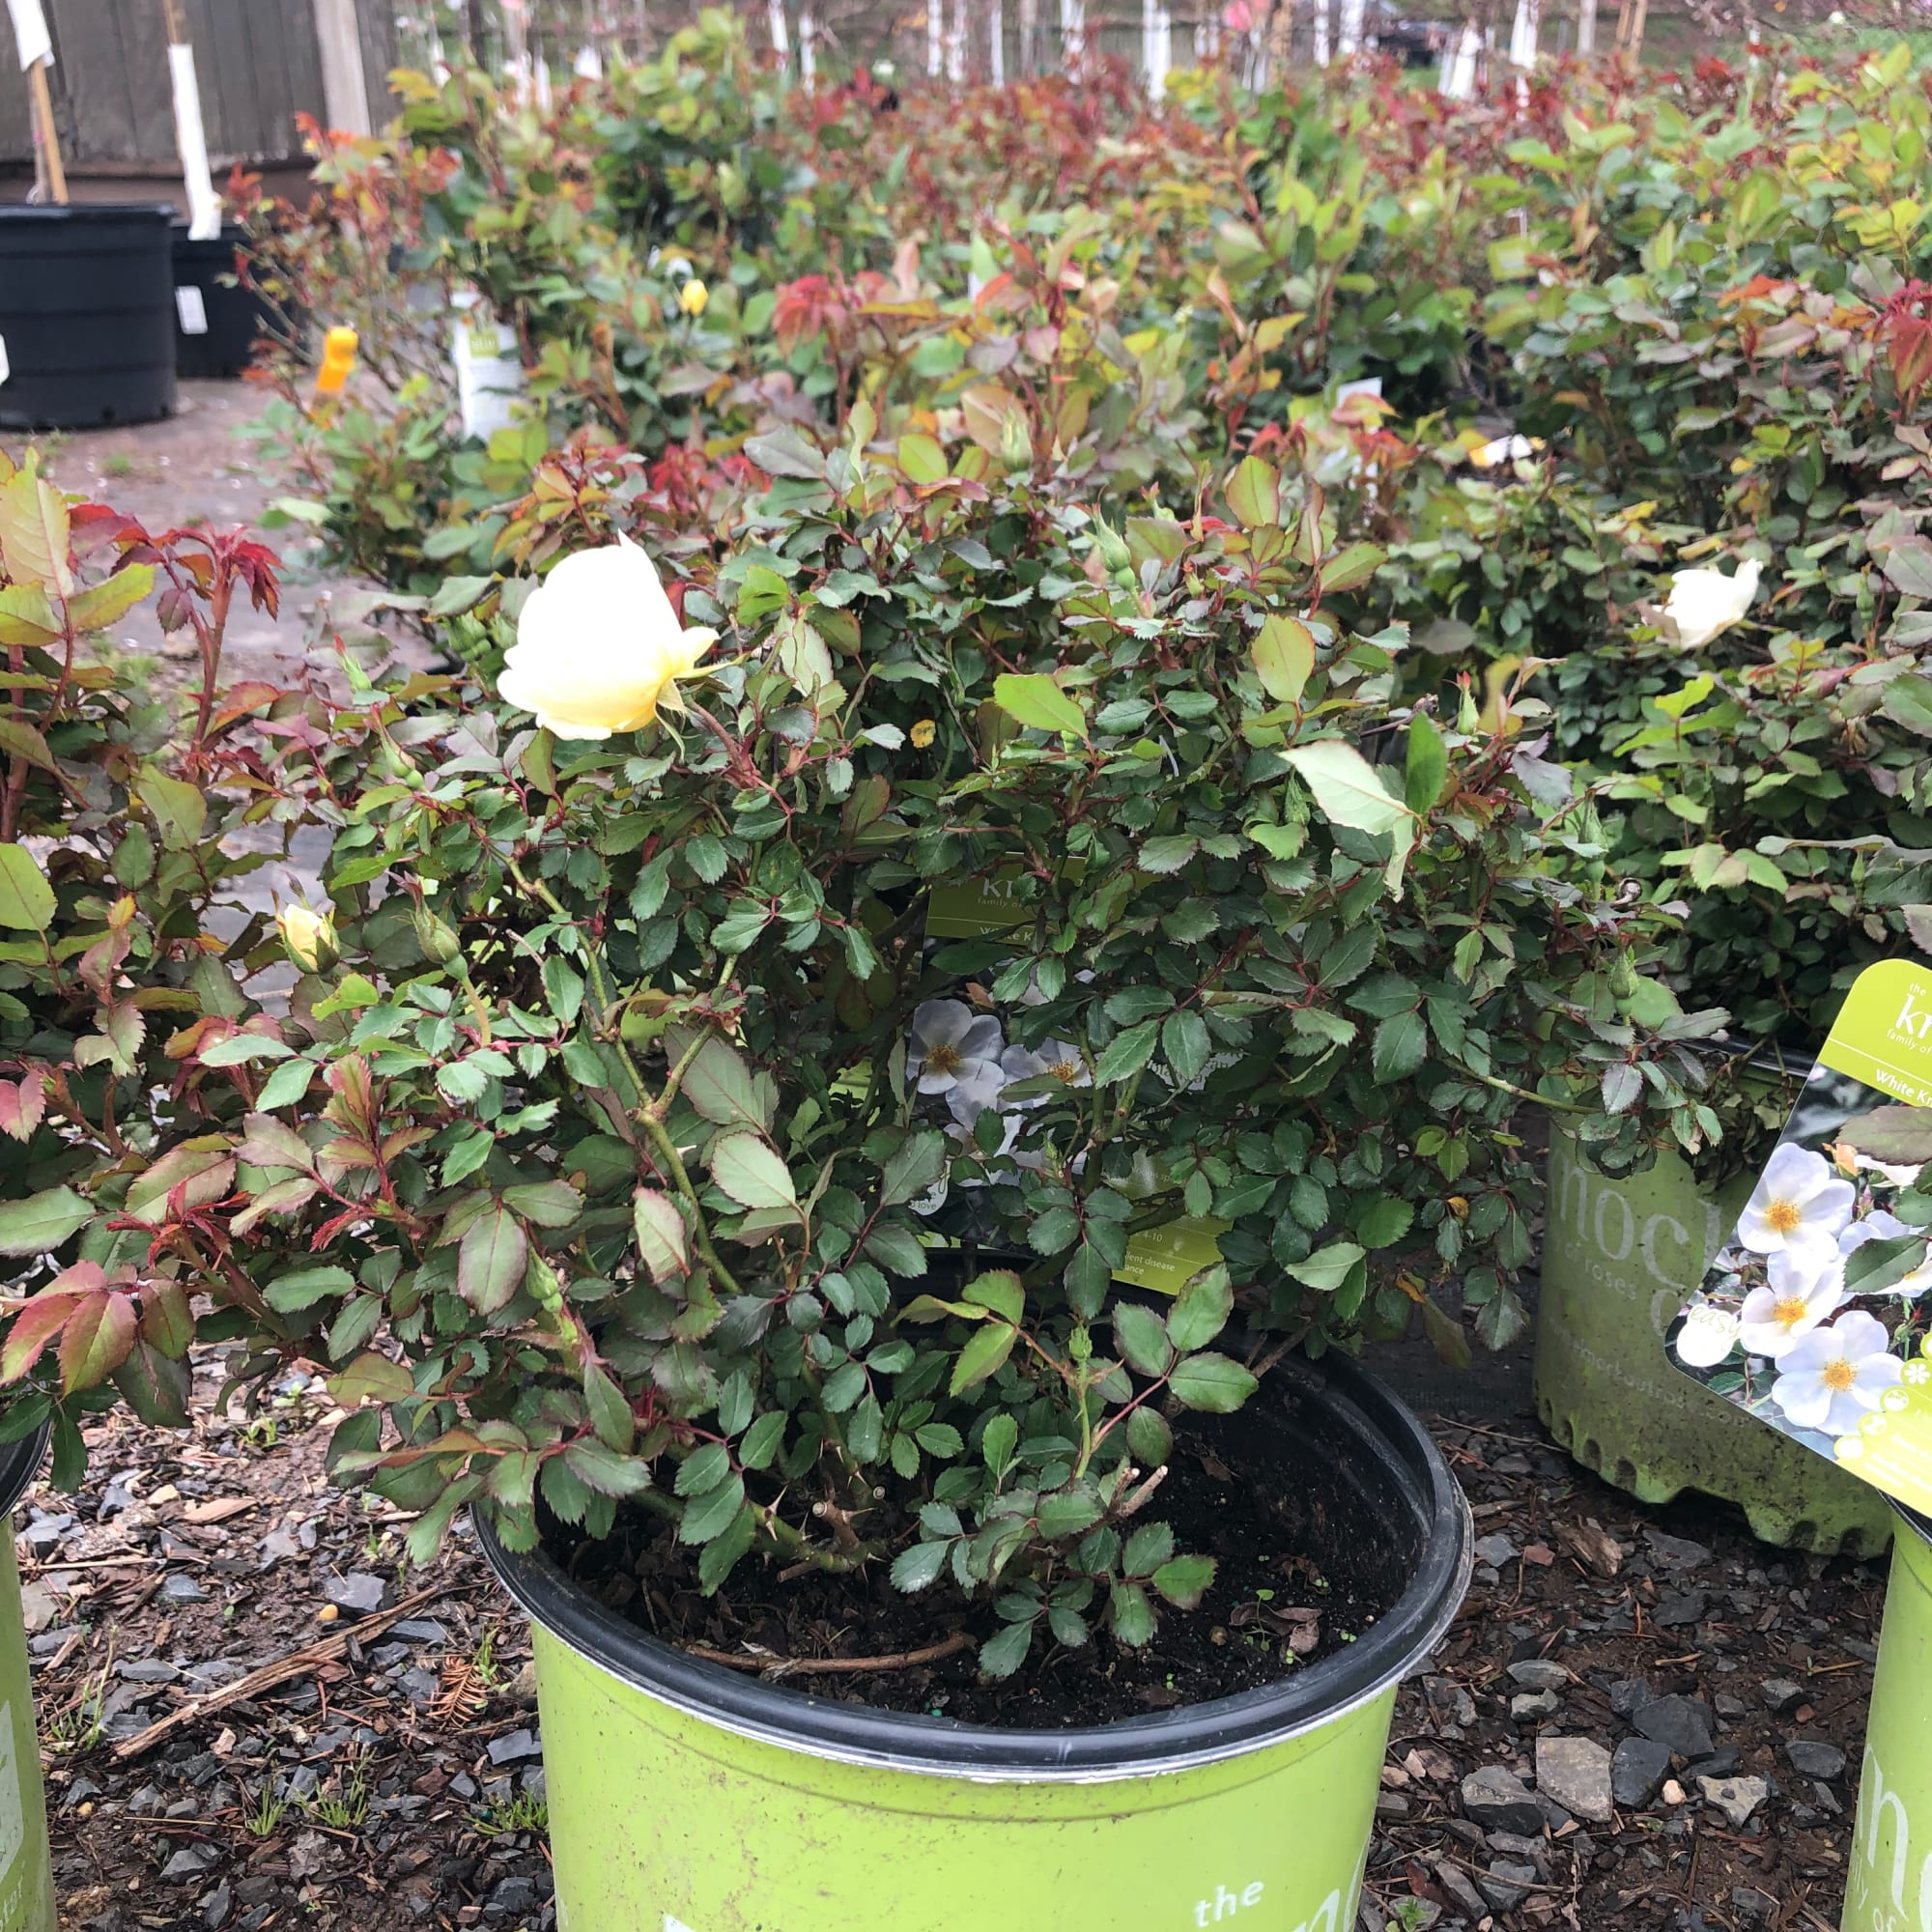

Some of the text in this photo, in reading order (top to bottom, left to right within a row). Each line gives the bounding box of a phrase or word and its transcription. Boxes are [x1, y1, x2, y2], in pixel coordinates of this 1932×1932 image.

[1909, 981, 1927, 997] the
[1887, 1027, 1918, 1051] family
[1876, 1068, 1916, 1098] White
[1144, 1257, 1176, 1272] disease
[1584, 1257, 1637, 1301] roses
[1690, 1306, 1743, 1342] easy
[1194, 1880, 1265, 1929] the
